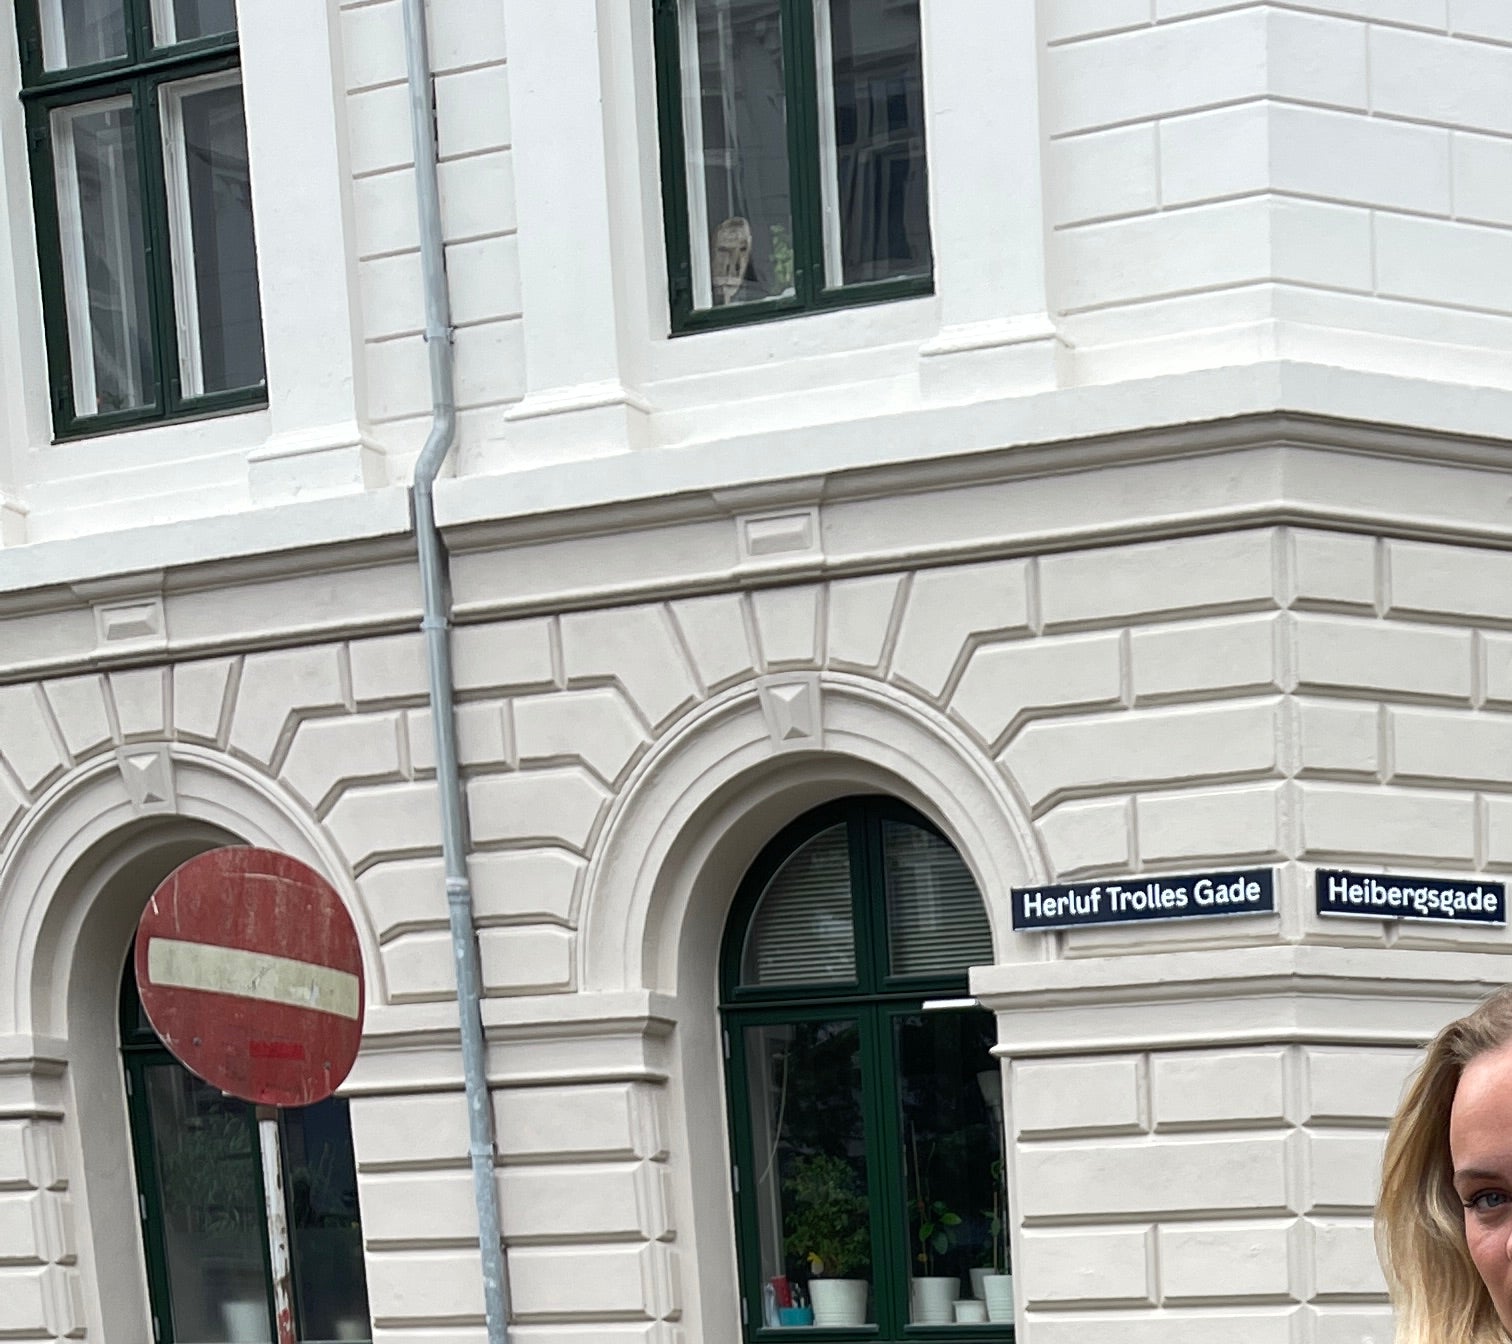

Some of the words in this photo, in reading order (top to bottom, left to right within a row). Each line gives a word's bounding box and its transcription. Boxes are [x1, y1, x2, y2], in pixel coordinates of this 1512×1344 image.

[1023, 887, 1101, 918] Herluf
[1106, 883, 1188, 911] Trolles
[1193, 876, 1261, 905] Gade
[1328, 876, 1498, 916] Heibergsgade
